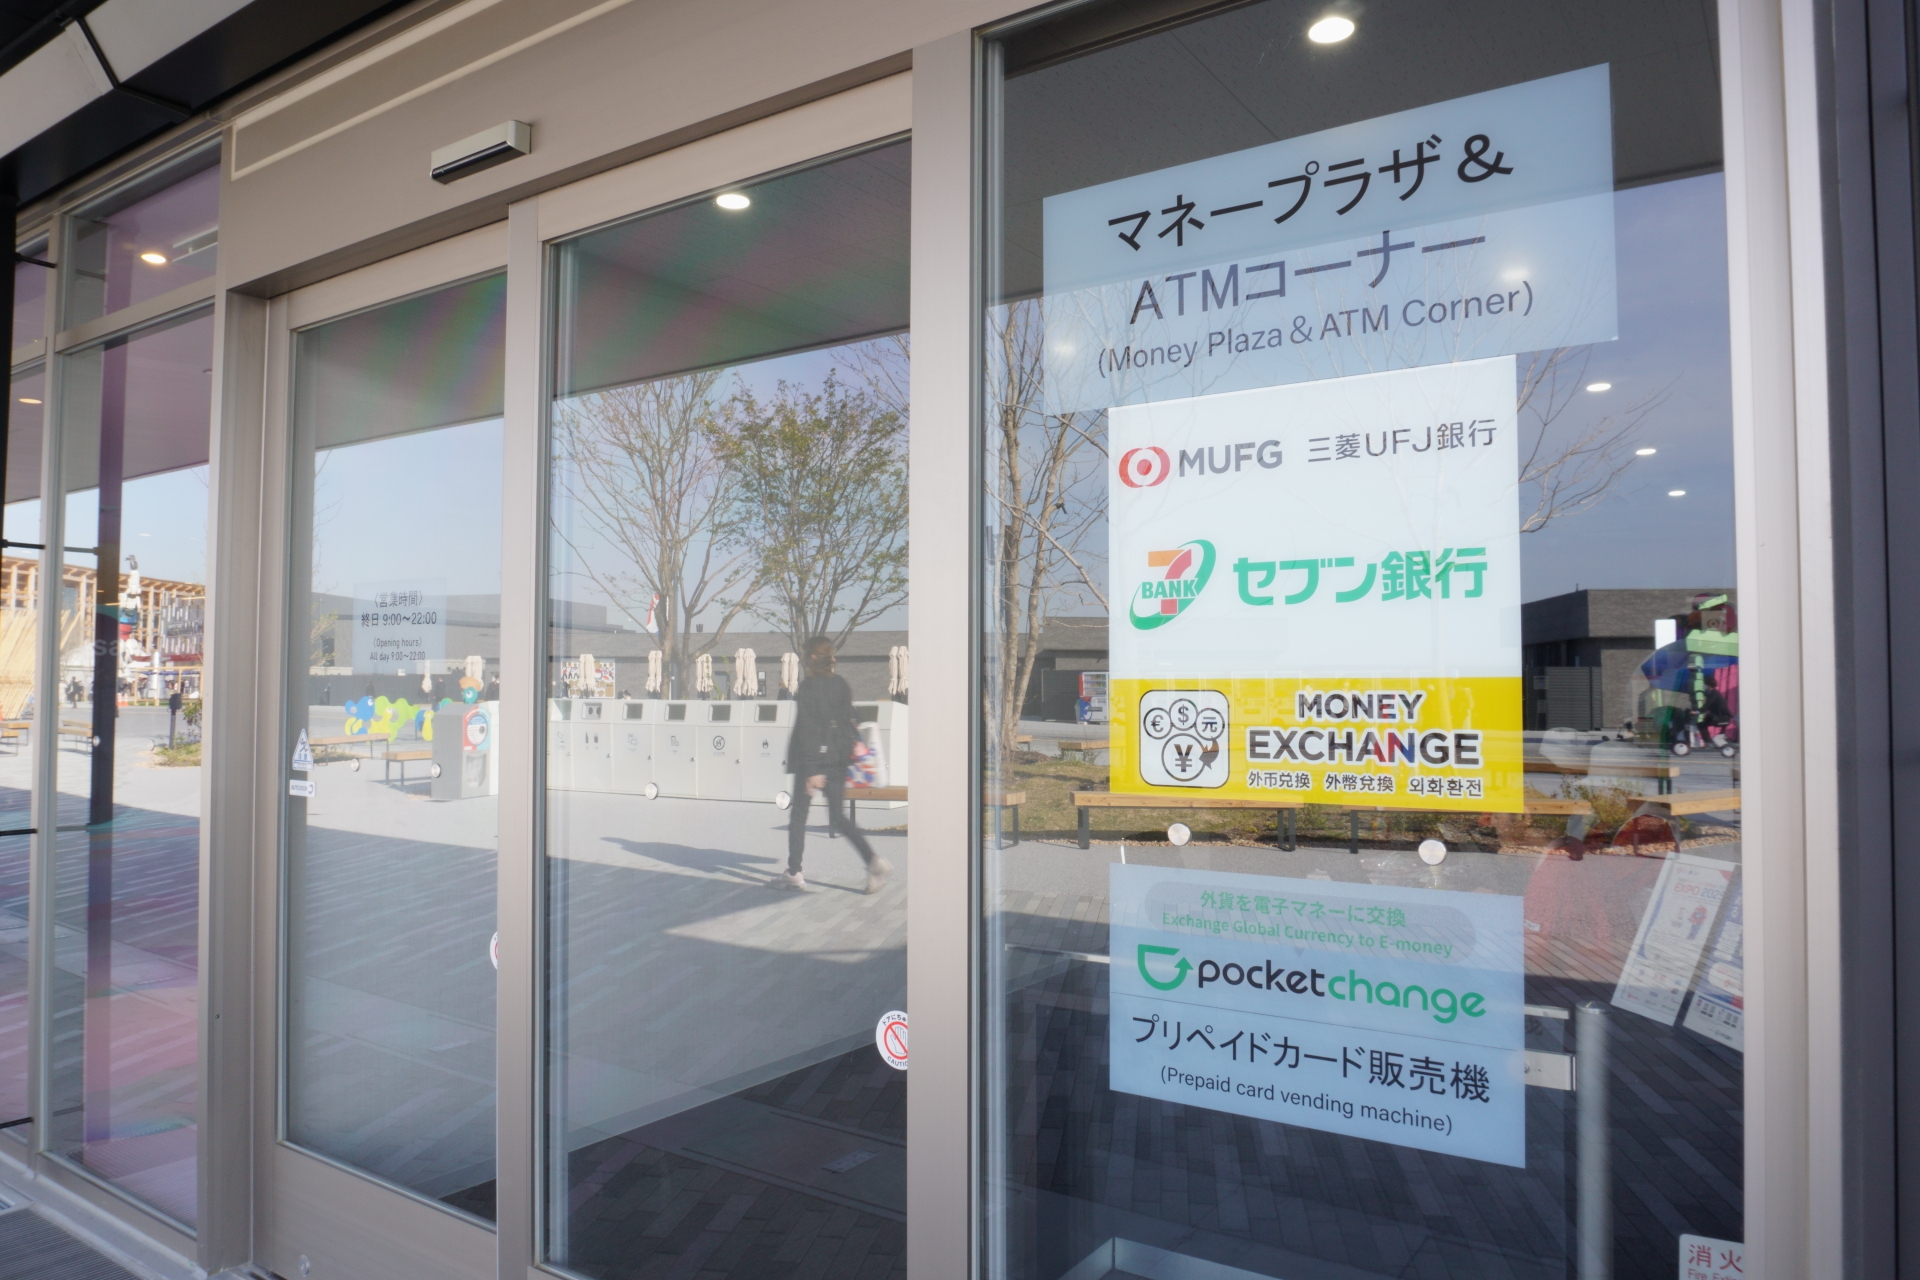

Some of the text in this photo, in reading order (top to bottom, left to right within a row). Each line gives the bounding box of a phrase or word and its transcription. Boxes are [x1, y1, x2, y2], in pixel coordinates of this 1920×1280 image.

[1108, 133, 1514, 251] マネープラザ &
[1129, 229, 1486, 325] ATMコーナー
[1098, 280, 1534, 378] (Money Plaza & ATM Corner)
[1179, 439, 1283, 478] MUFG
[1307, 418, 1497, 463] 三菱UFJ銀行
[1141, 577, 1199, 600] BANK
[1233, 547, 1488, 606] セブン銀行
[361, 612, 379, 628] 終日
[370, 652, 378, 661] All
[379, 652, 390, 663] day
[1298, 693, 1423, 720] MONEY
[1249, 730, 1479, 766] EXCHANGE
[1248, 771, 1310, 789] 外币兑换
[1409, 777, 1482, 797] 외화환전
[1674, 882, 1701, 895] EXPO
[1200, 889, 1406, 928] 外貨を電子マネーに交換
[1162, 912, 1452, 959] Exchange Global Currency to E-money
[1198, 959, 1487, 1024] pocketchange
[1132, 1014, 1490, 1103] プリペイドカード販売機
[1160, 1065, 1452, 1136] (Prepaid card vending machine)
[1688, 1244, 1744, 1273] 消火
